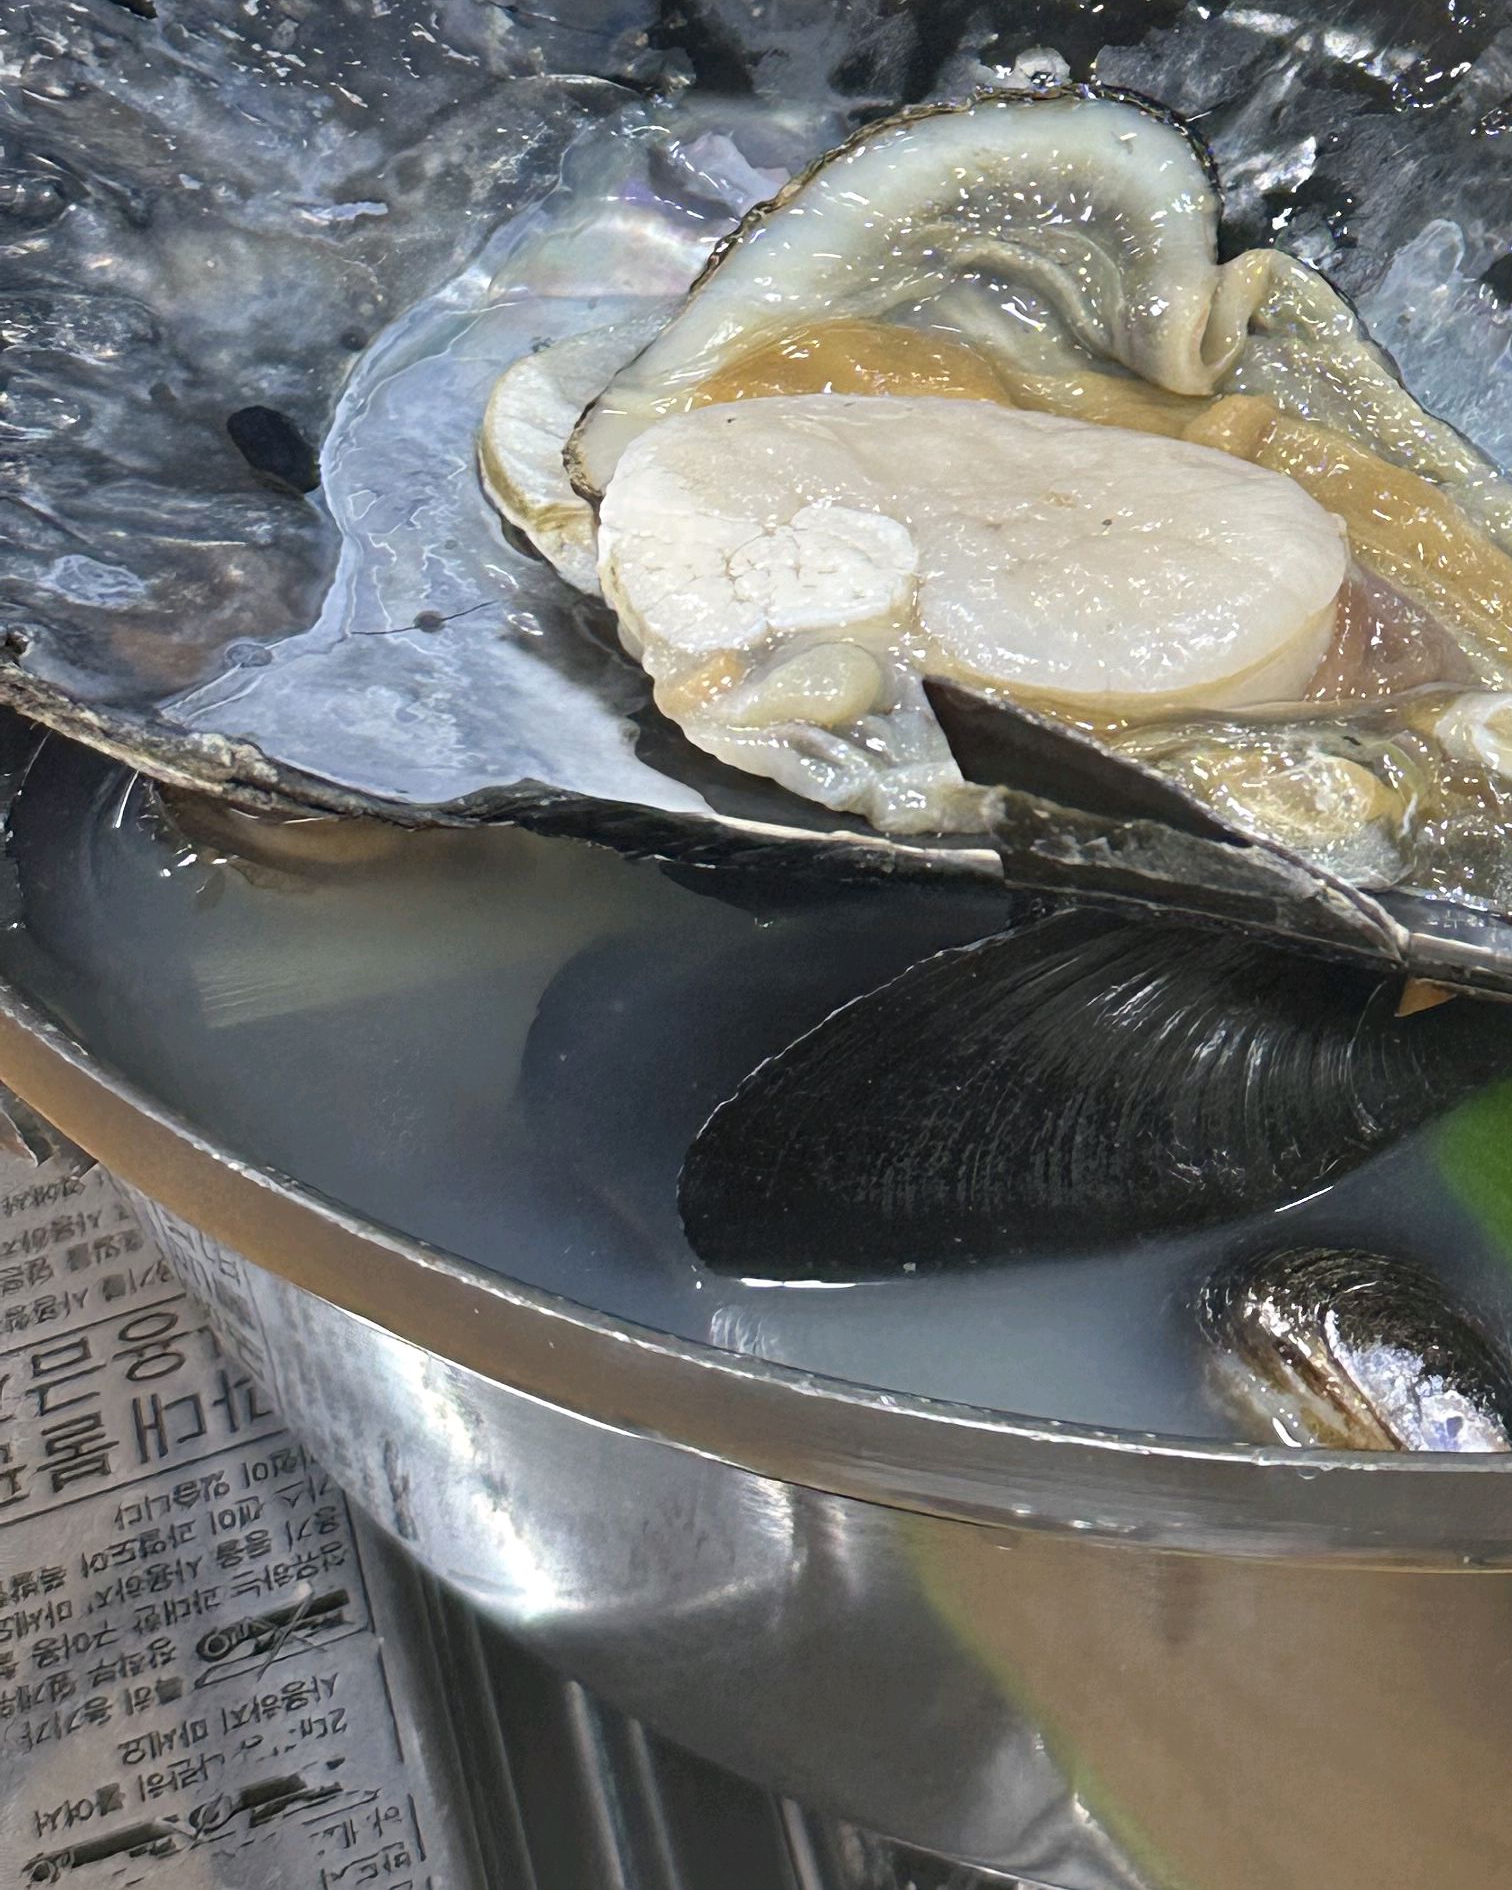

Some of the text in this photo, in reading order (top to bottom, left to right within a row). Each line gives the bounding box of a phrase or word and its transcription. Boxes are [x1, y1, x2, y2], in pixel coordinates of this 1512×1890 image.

[114, 1471, 230, 1531] 있습니다
[210, 1496, 263, 1535] 캔이
[274, 1475, 329, 1510] 가스
[216, 1529, 271, 1569] 등을
[285, 1505, 341, 1553] 용기
[87, 1556, 202, 1614] 사용하지
[133, 1587, 221, 1637] 과대한
[31, 1618, 120, 1669] 구이용
[117, 1672, 339, 1765] 사용하지 마세요
[138, 1753, 225, 1803] 나란히
